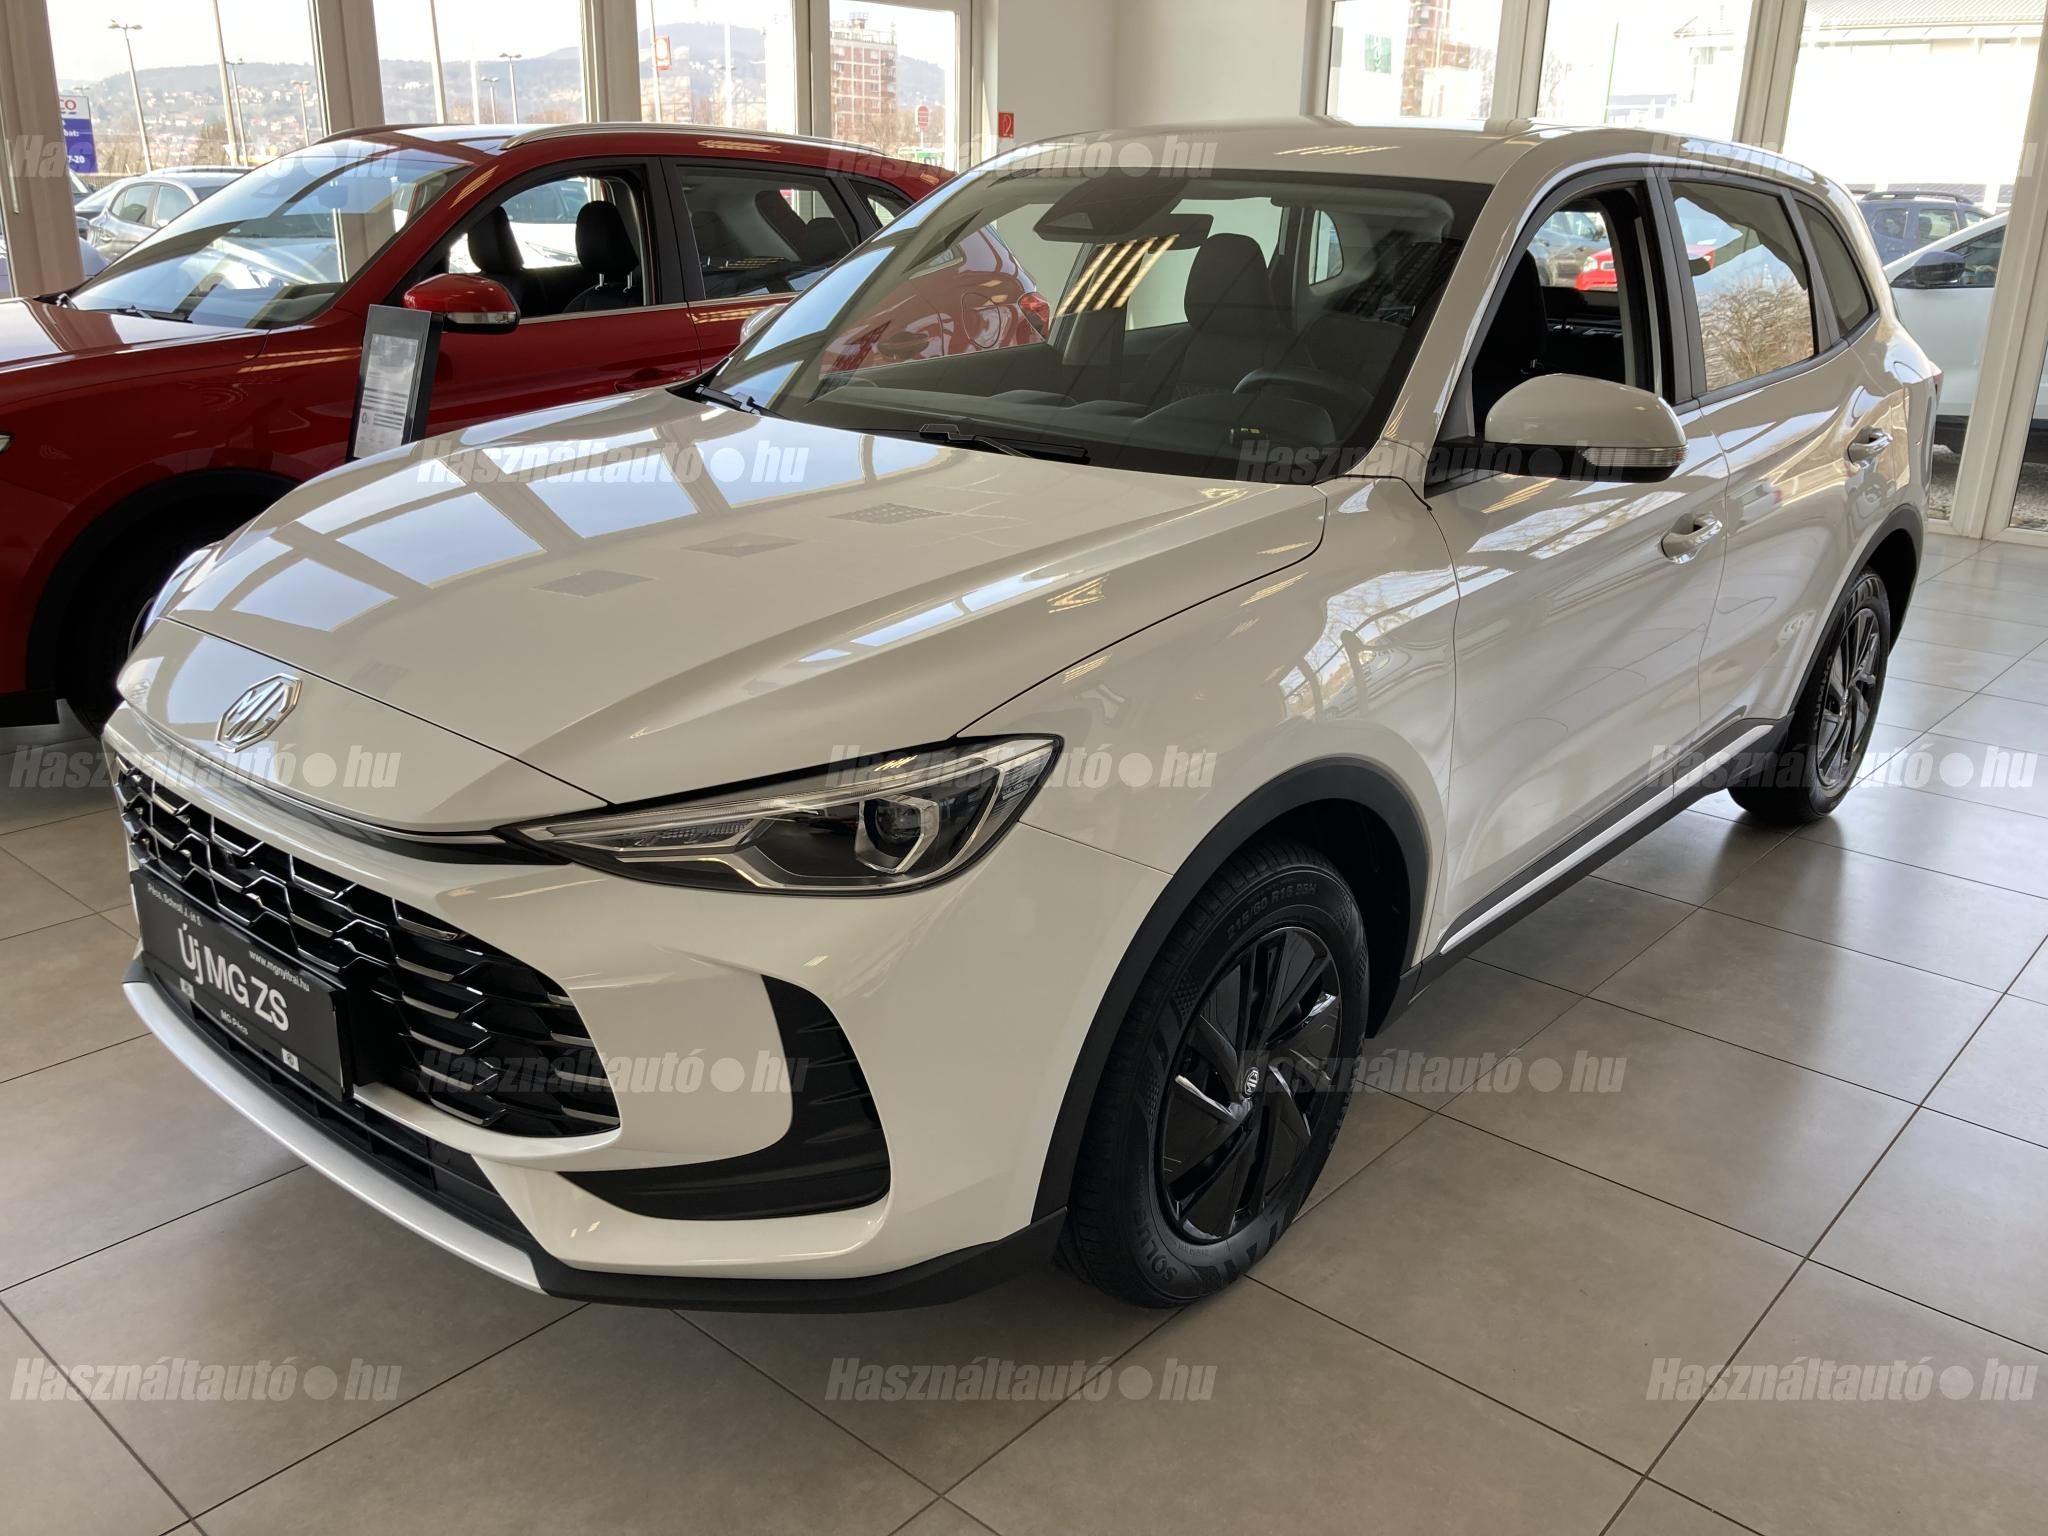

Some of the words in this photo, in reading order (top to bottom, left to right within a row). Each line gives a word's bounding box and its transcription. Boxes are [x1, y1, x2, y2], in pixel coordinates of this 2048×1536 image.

[178, 923, 203, 985] Új
[203, 945, 250, 1008] MG
[250, 976, 289, 1031] ZS
